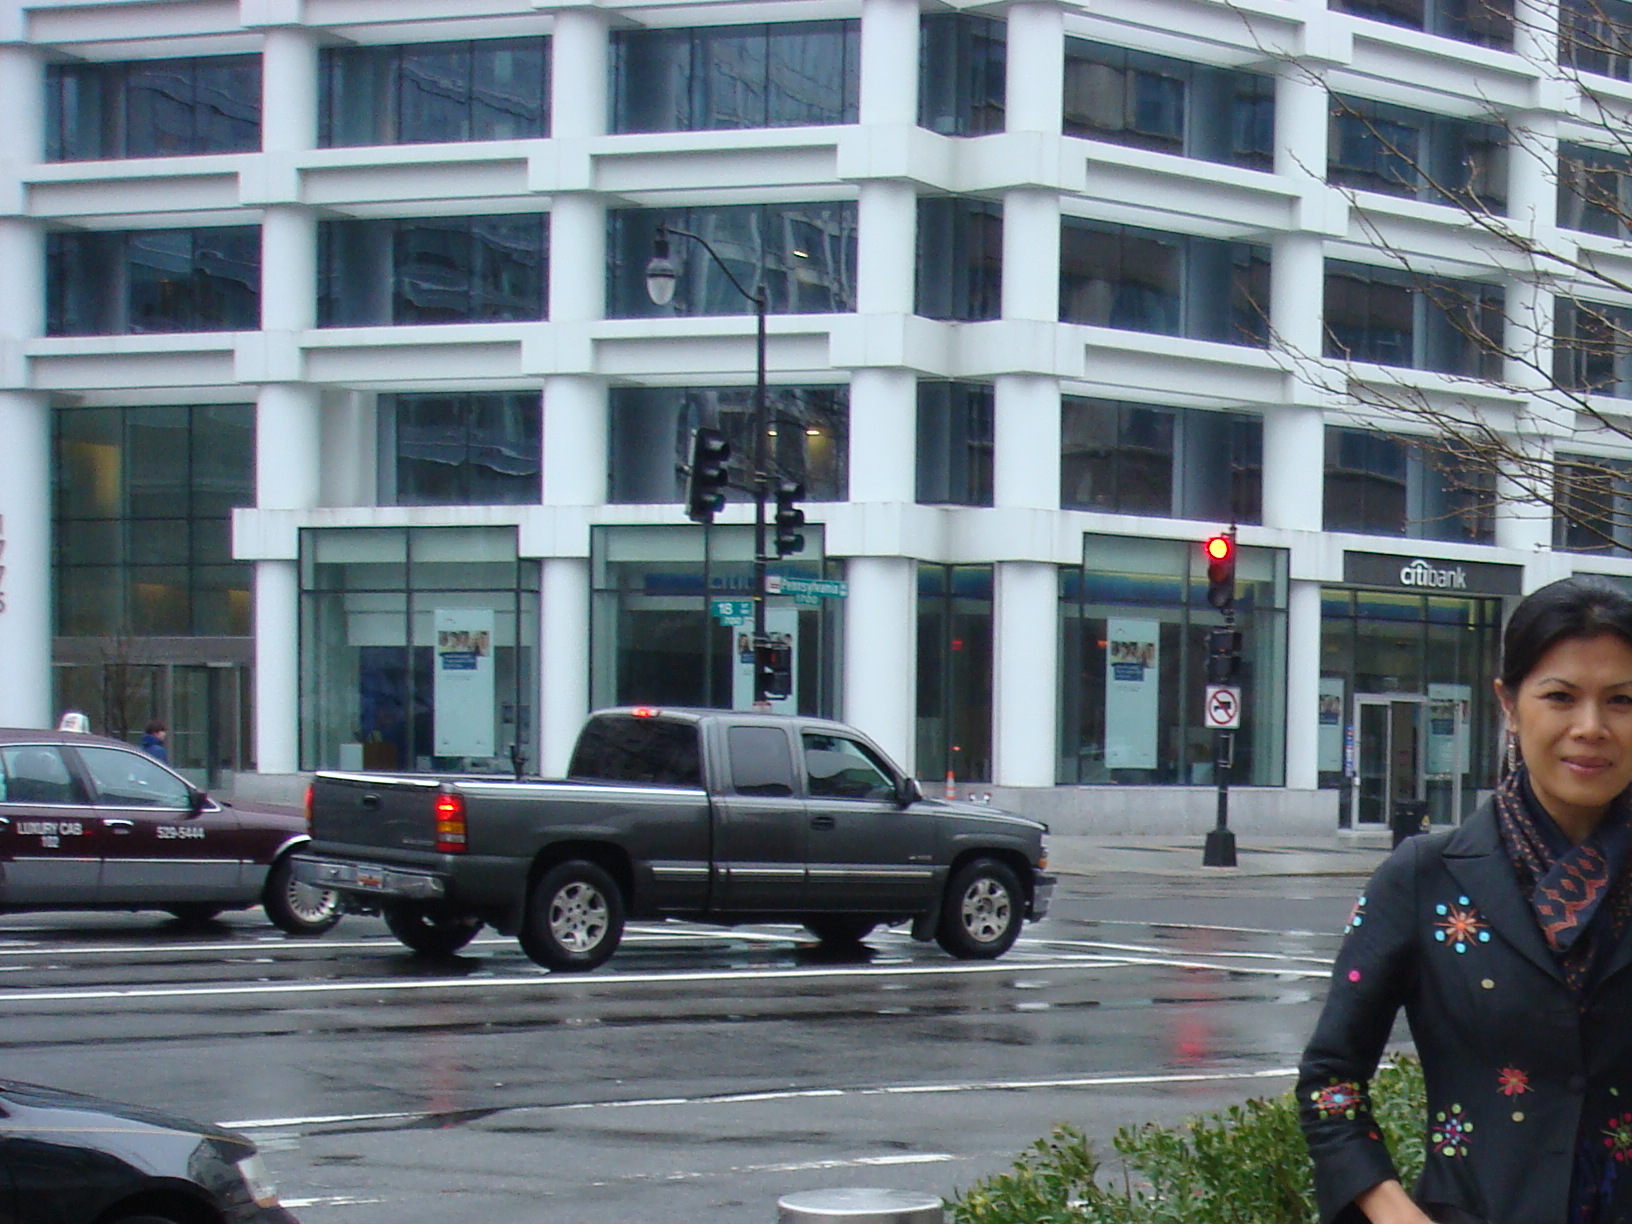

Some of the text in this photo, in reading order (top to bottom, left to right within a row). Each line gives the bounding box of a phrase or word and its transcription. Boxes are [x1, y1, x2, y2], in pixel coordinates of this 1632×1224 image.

[1400, 559, 1467, 588] citibank
[782, 579, 838, 595] Pennsylvania
[718, 602, 733, 615] 18
[17, 822, 83, 836] LUXURY CAB
